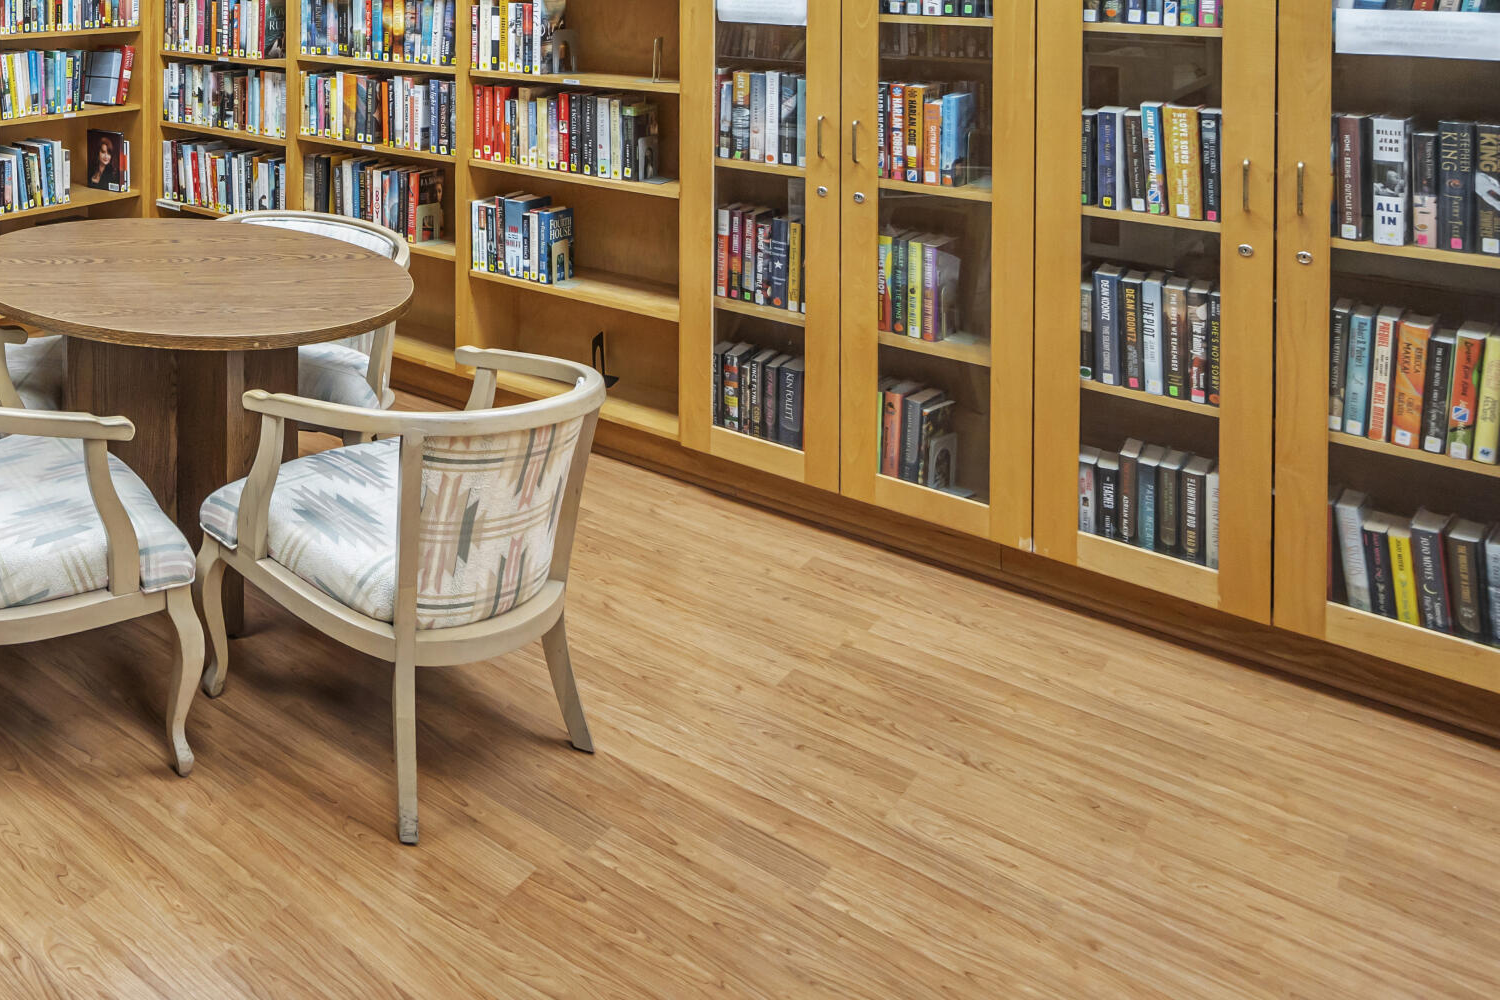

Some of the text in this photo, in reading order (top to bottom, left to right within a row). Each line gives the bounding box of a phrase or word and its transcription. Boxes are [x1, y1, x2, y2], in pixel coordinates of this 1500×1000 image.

[892, 98, 903, 156] HARLAN COBEN
[908, 100, 916, 127] HARLAN
[1441, 131, 1458, 171] KING
[1460, 133, 1471, 172] STEPHEN
[1479, 133, 1497, 173] KING
[1376, 202, 1402, 213] ALL
[1381, 216, 1397, 225] IN
[550, 216, 572, 229] FOURTH
[550, 226, 572, 240] HOUSE
[1101, 279, 1110, 320] DEAN KOONTZ
[1126, 288, 1136, 342] DEAN KOONTZ
[1143, 302, 1154, 338] THE PLOT
[1211, 343, 1219, 362] NOT
[1401, 342, 1412, 374] MAKKAI
[1211, 364, 1219, 390] SORRY
[784, 372, 794, 421] KEN FOLLETT
[1103, 483, 1114, 509] TEACHER
[1146, 485, 1154, 512] PAULA
[1187, 483, 1196, 515] LIGHTNING
[1422, 555, 1433, 580] MOYES
